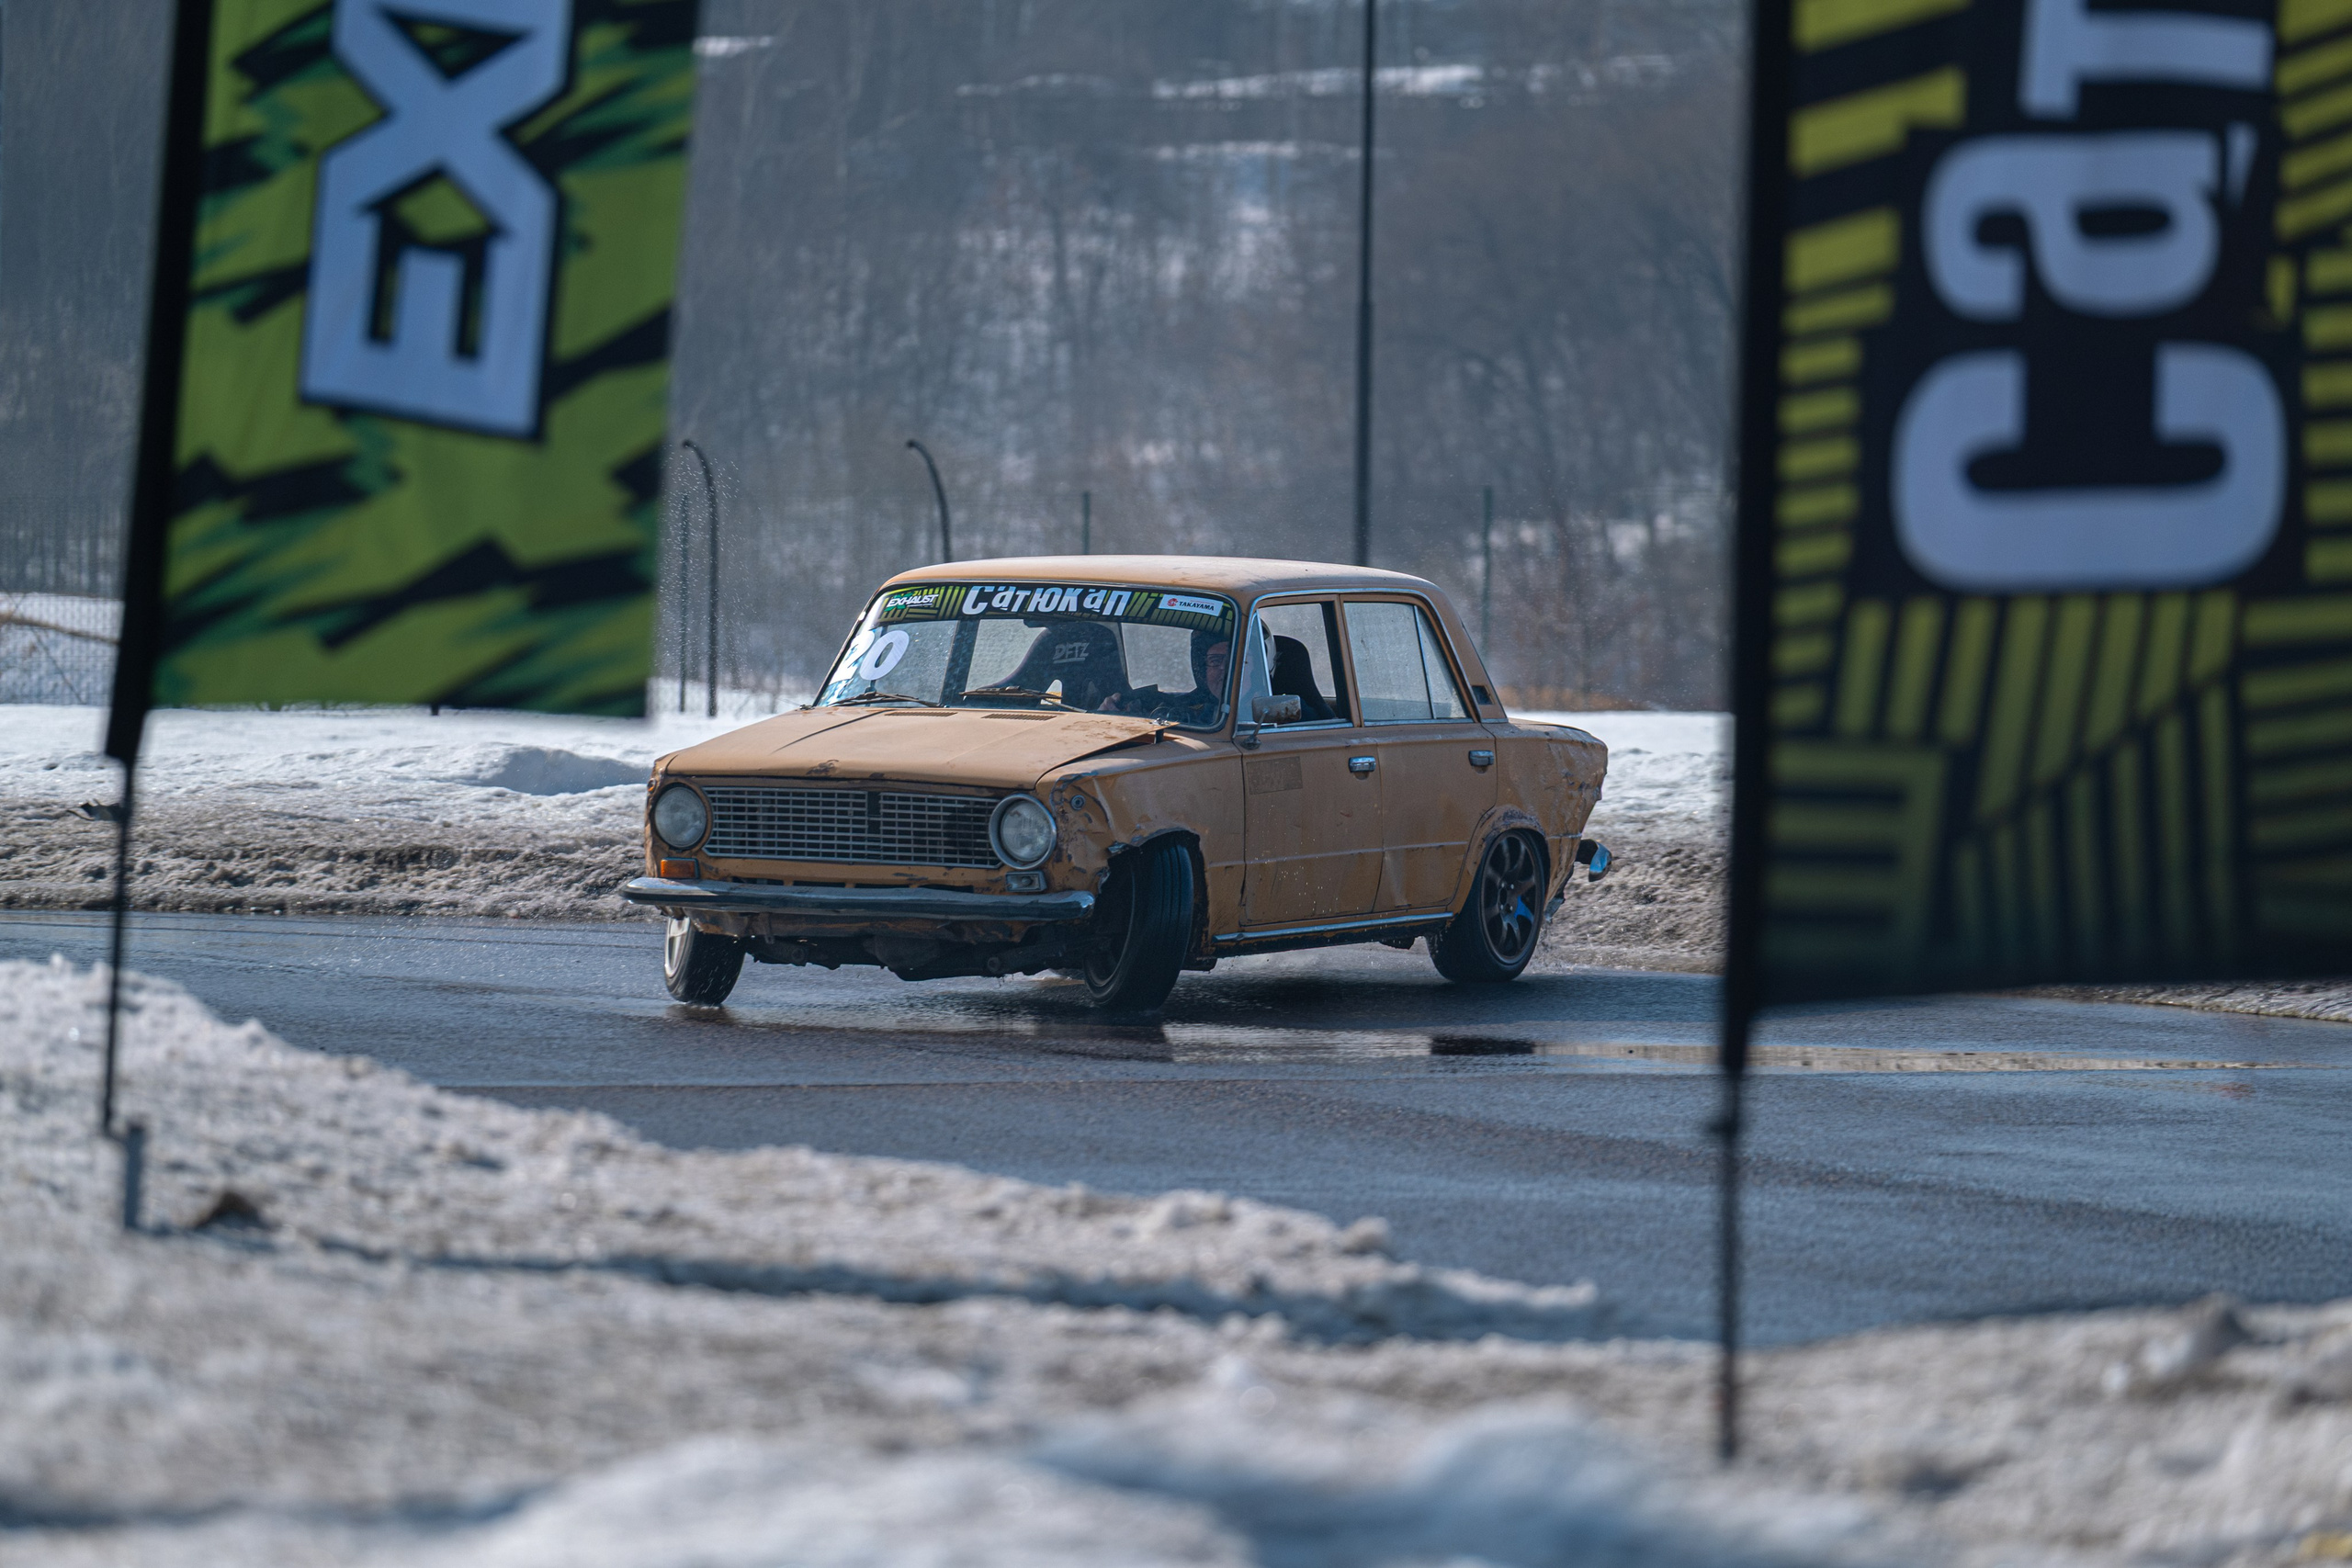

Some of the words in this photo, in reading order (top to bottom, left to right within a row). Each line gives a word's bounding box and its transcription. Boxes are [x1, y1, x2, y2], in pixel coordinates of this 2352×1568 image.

[301, 0, 571, 437] EX
[887, 594, 939, 607] EXHAUST
[1179, 601, 1215, 612] TAKAYAMA
